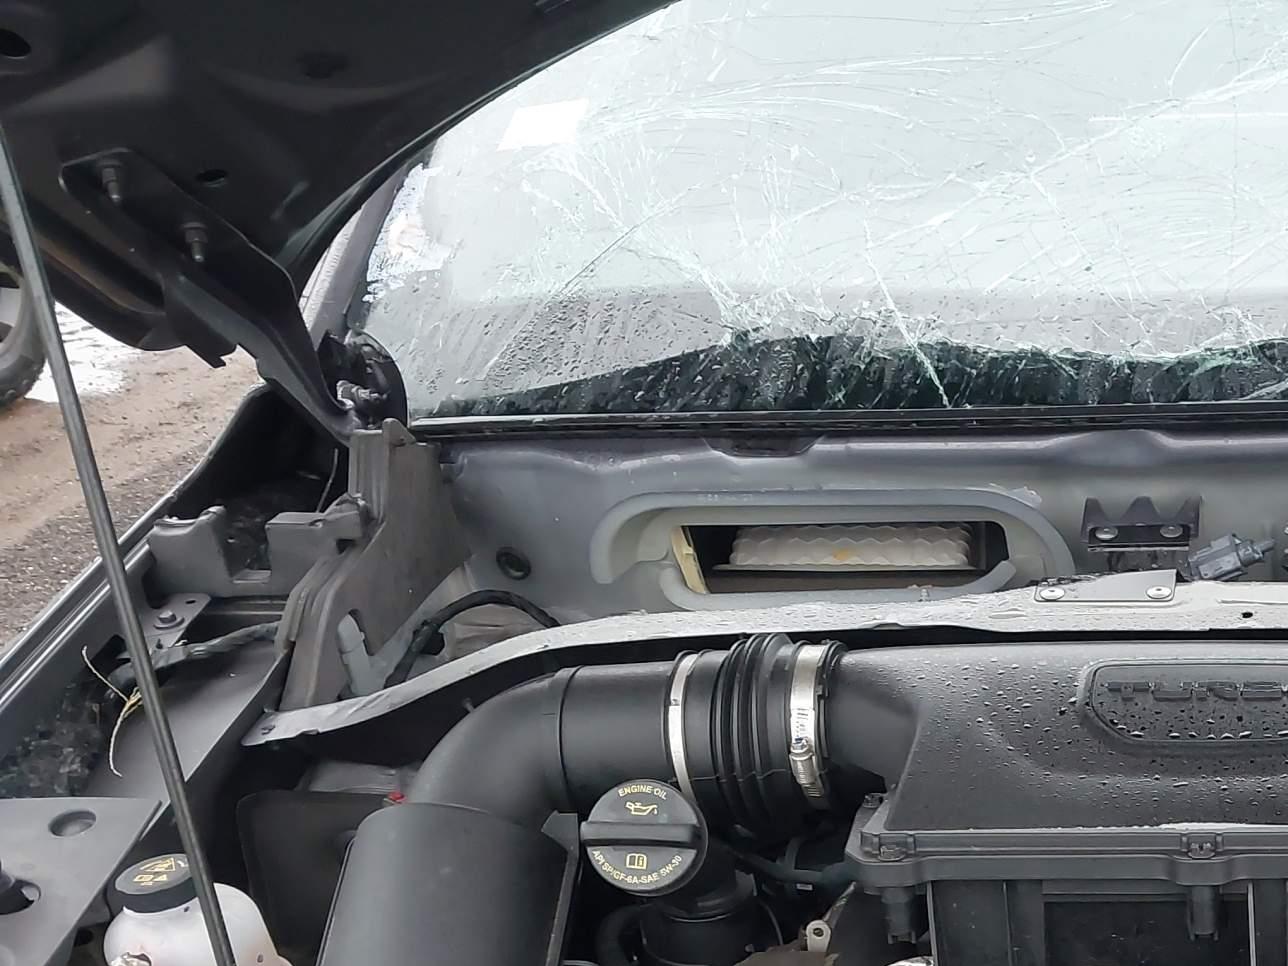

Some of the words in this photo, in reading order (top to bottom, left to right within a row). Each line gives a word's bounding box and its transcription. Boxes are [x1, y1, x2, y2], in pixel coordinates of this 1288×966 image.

[618, 784, 653, 797] ENGINE
[653, 787, 667, 800] OIL
[592, 850, 606, 865] API
[660, 854, 682, 877] 5W-30
